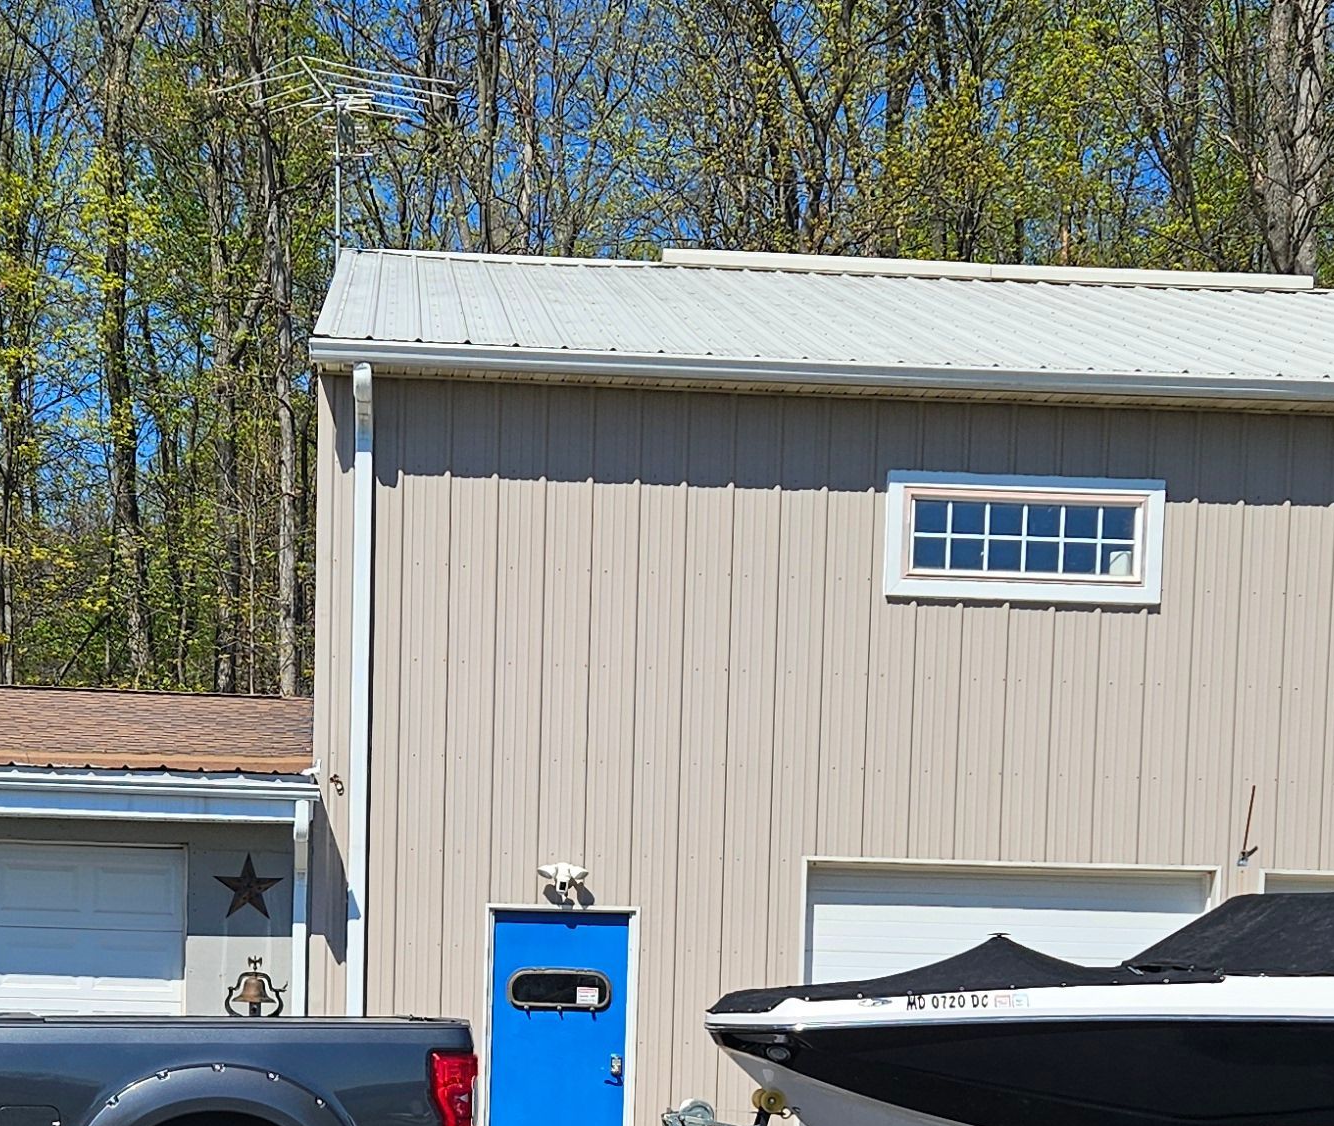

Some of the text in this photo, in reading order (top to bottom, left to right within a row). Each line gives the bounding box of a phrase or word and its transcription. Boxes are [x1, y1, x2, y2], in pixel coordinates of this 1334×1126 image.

[906, 994, 926, 1011] MD
[931, 994, 966, 1009] 0720
[971, 994, 989, 1009] DC
